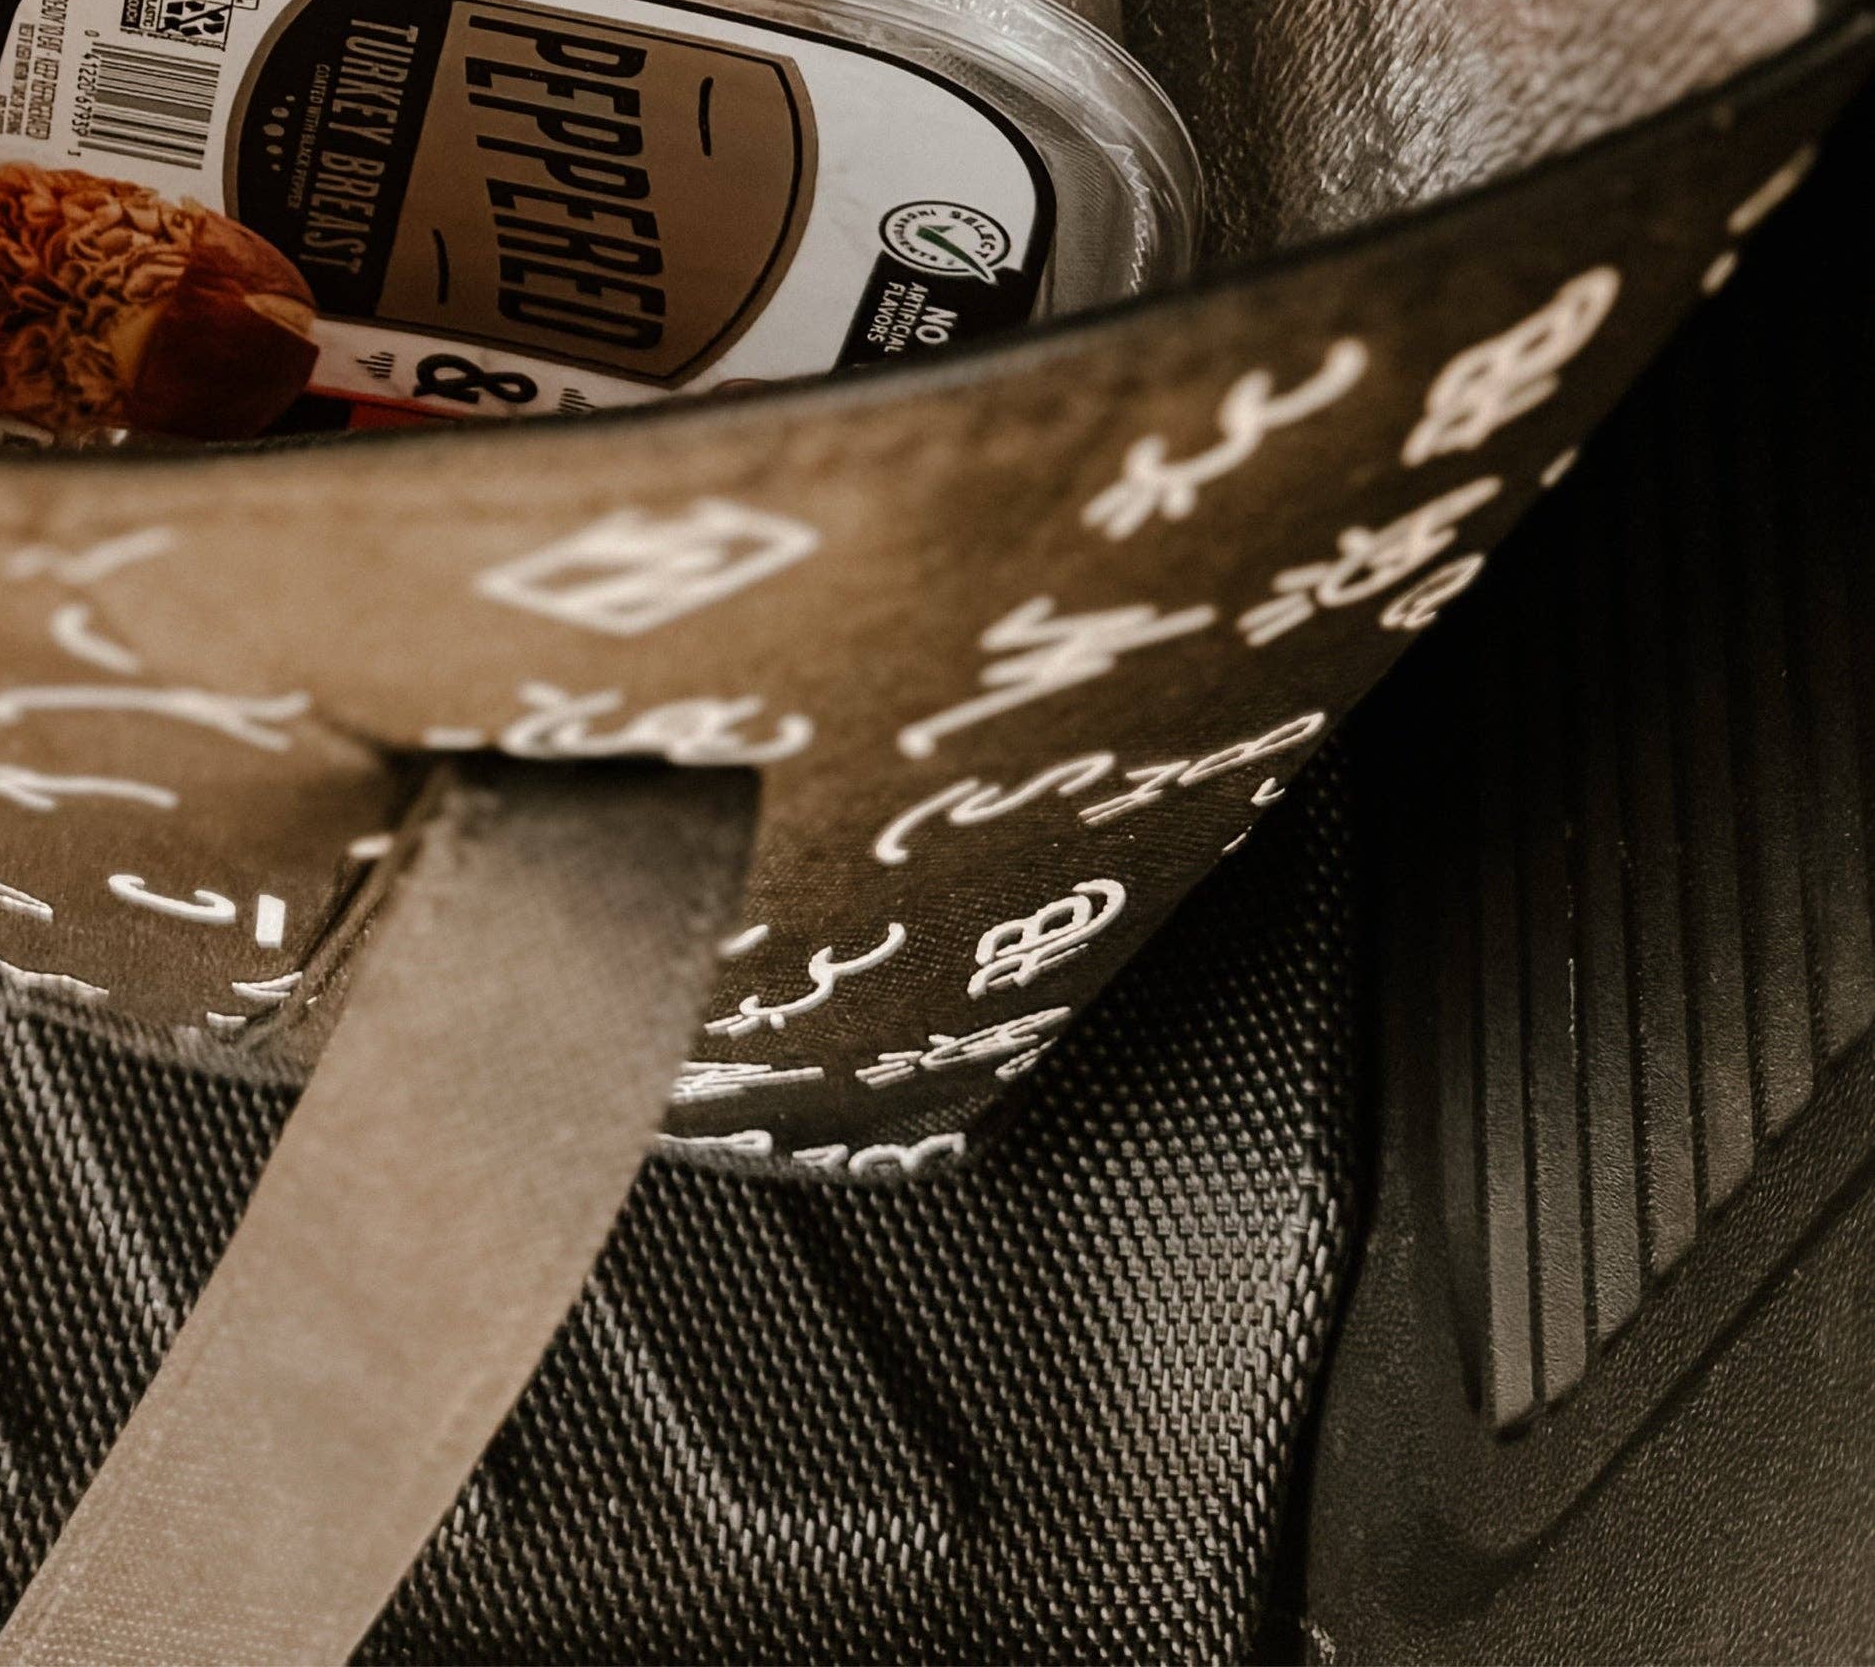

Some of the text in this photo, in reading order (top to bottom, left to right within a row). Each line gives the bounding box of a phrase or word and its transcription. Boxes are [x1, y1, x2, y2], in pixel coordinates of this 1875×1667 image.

[299, 18, 419, 274] TURKEY BREAST
[464, 14, 666, 350] PEPPERED
[950, 210, 996, 259] SELECT
[868, 281, 905, 342] FLAVORS
[884, 282, 929, 352] ARTIFICIAL
[915, 306, 957, 344] NO
